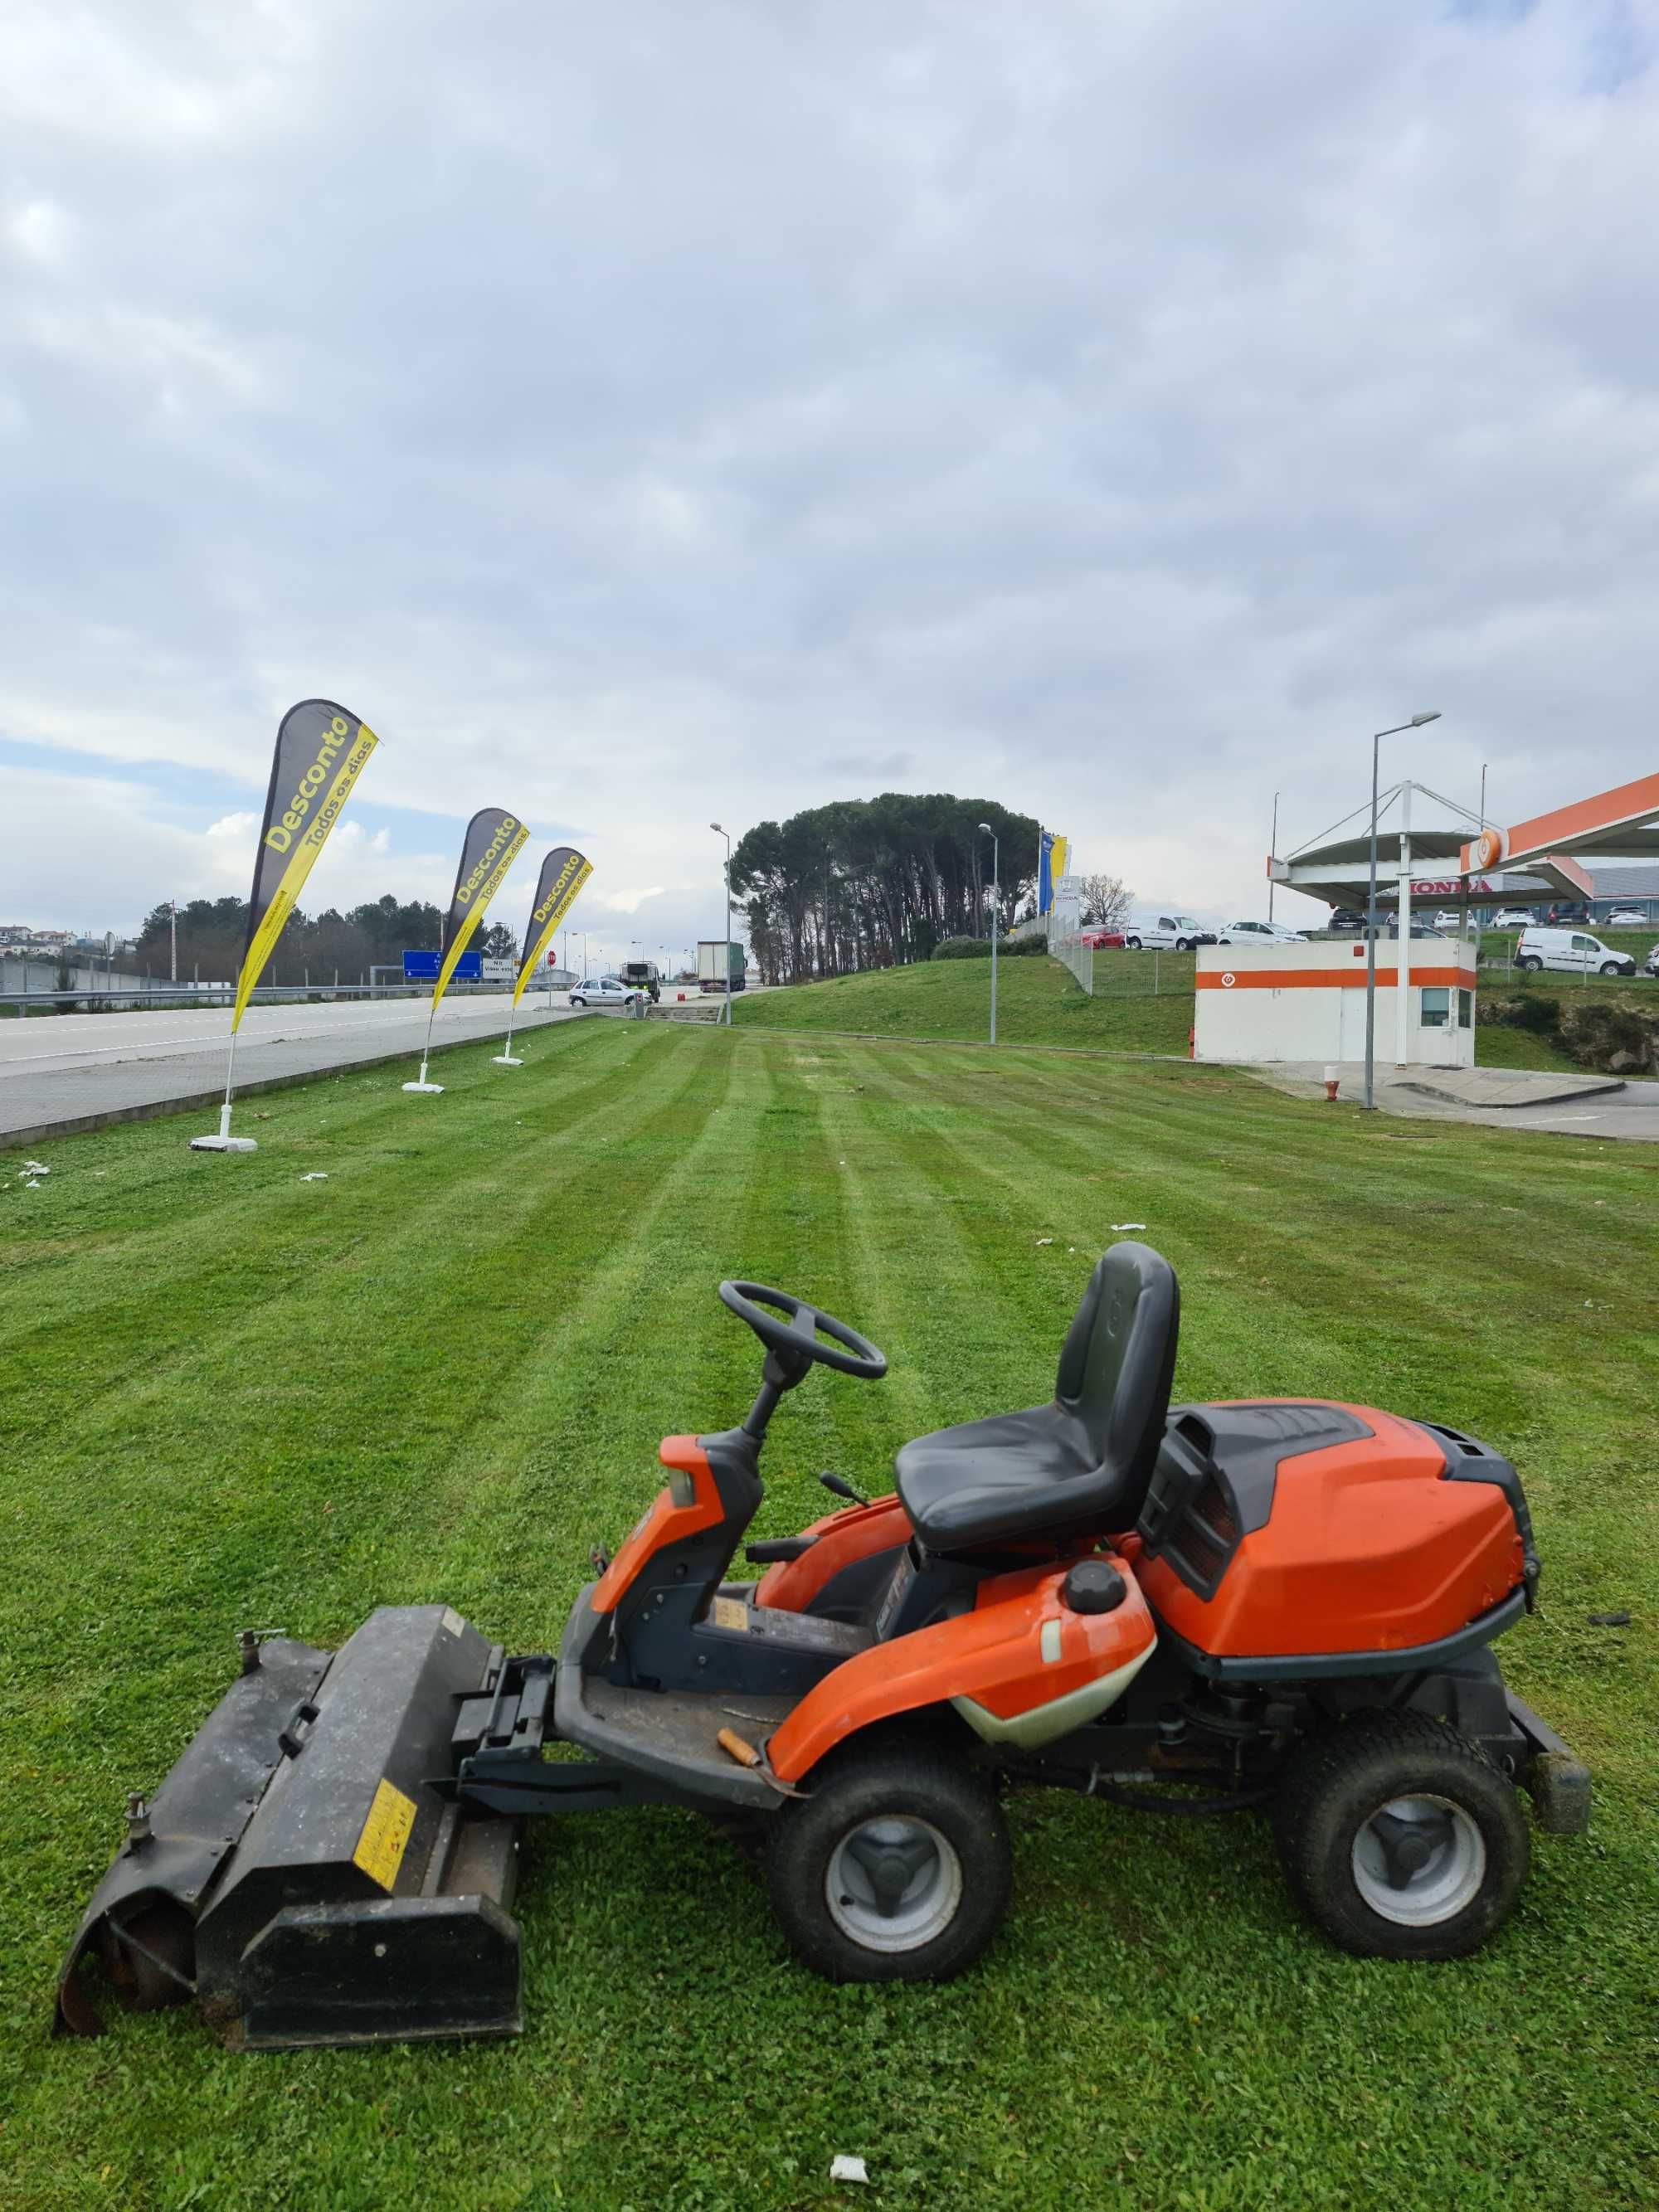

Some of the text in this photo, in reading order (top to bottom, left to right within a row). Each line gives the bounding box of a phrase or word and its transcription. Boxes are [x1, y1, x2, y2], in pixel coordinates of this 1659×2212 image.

[265, 717, 348, 854] Desconto
[305, 741, 372, 847] Todos os dias
[456, 817, 515, 904] Desconto
[480, 833, 527, 899] Todos os dias
[533, 855, 579, 923] Desconto
[553, 896, 572, 919] Todos
[577, 868, 590, 885] dias
